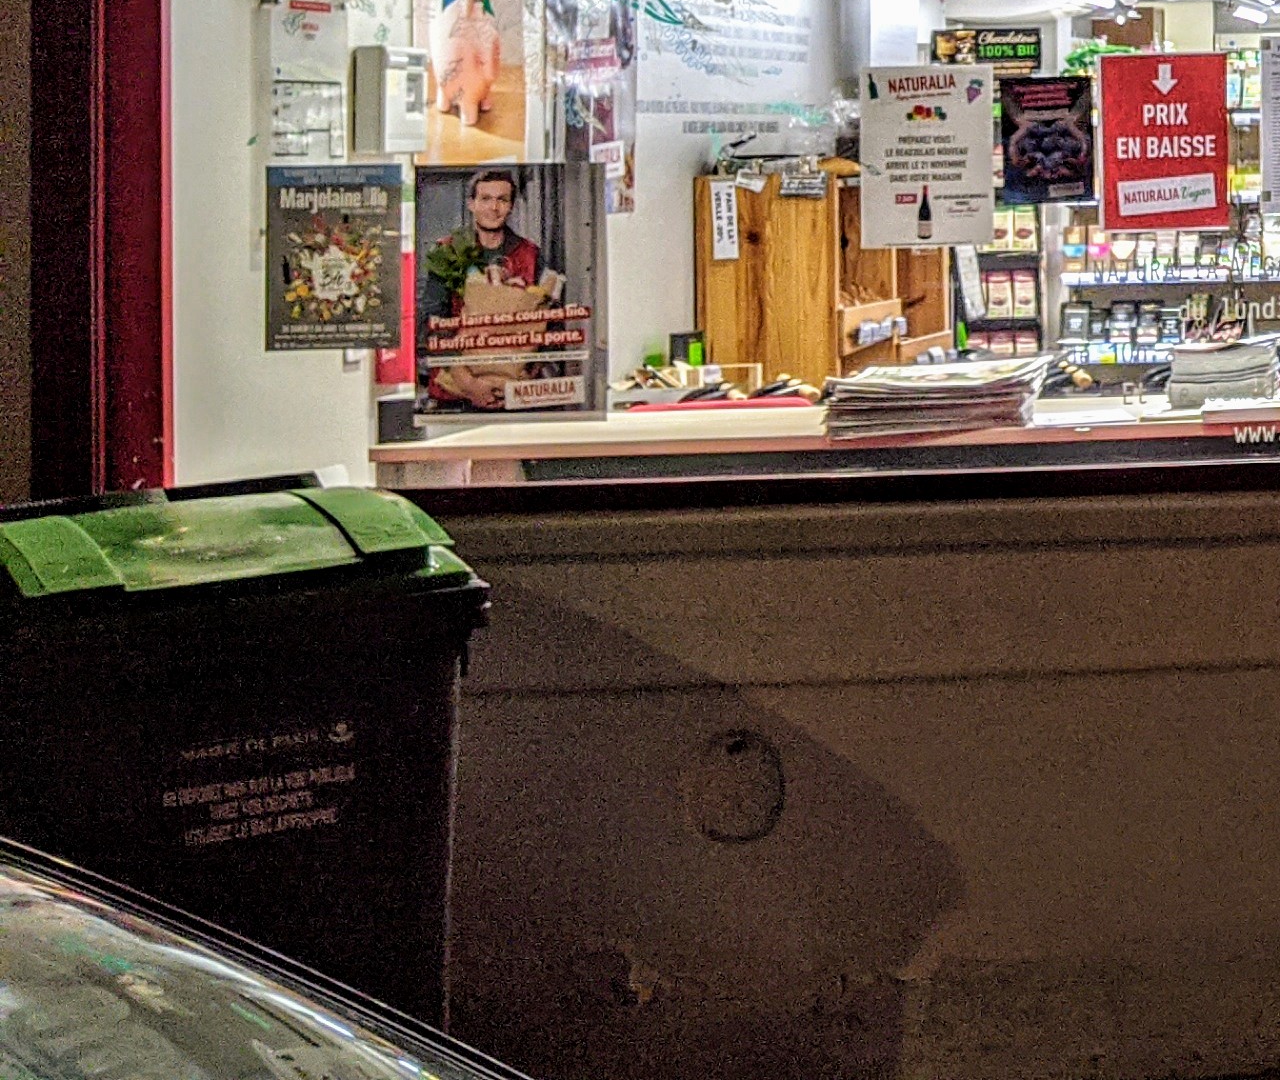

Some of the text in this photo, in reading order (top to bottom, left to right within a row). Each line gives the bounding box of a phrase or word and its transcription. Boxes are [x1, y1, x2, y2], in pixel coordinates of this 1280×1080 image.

[888, 73, 957, 95] NATURALIA
[1142, 102, 1189, 126] PRIX
[1116, 134, 1217, 159] EN BAISSE
[1123, 187, 1180, 205] NATURALIA
[429, 315, 461, 330] Pour
[516, 306, 565, 322] courses
[439, 333, 475, 350] suffit
[530, 331, 544, 344] la
[544, 328, 583, 346] porte.
[513, 380, 577, 399] NATURALIA
